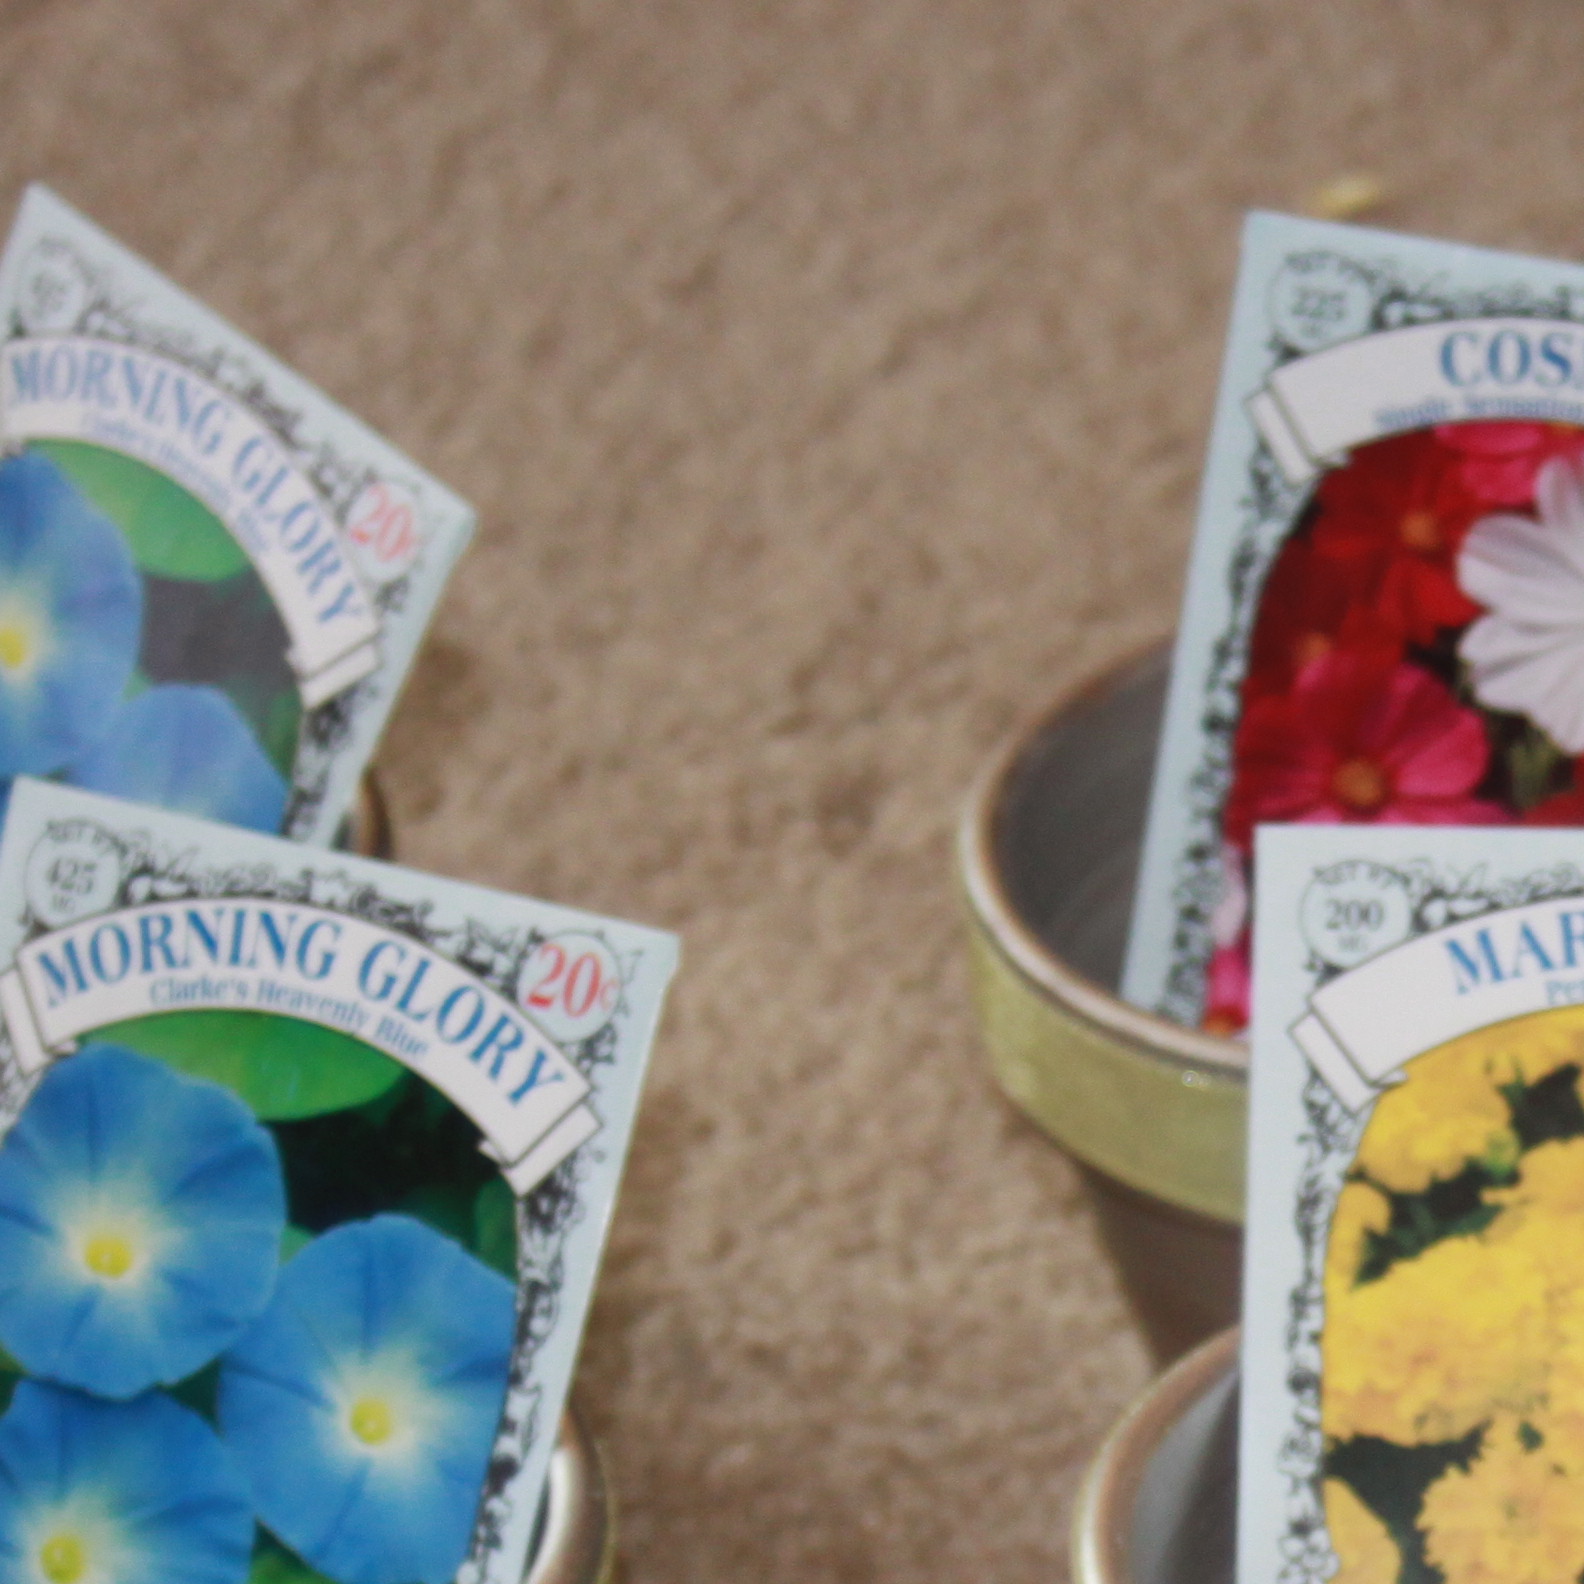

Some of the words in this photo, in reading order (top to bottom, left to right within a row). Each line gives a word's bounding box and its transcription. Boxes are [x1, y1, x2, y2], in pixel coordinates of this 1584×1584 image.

[11, 344, 223, 459] MORNING
[231, 437, 363, 625] GLORY
[1326, 898, 1385, 931] 200
[37, 907, 344, 1008] MORNING
[358, 938, 564, 1107] GLORY
[150, 976, 248, 1004] Clarke's
[258, 978, 369, 1028] Heavenly
[374, 1016, 430, 1055] Blue
